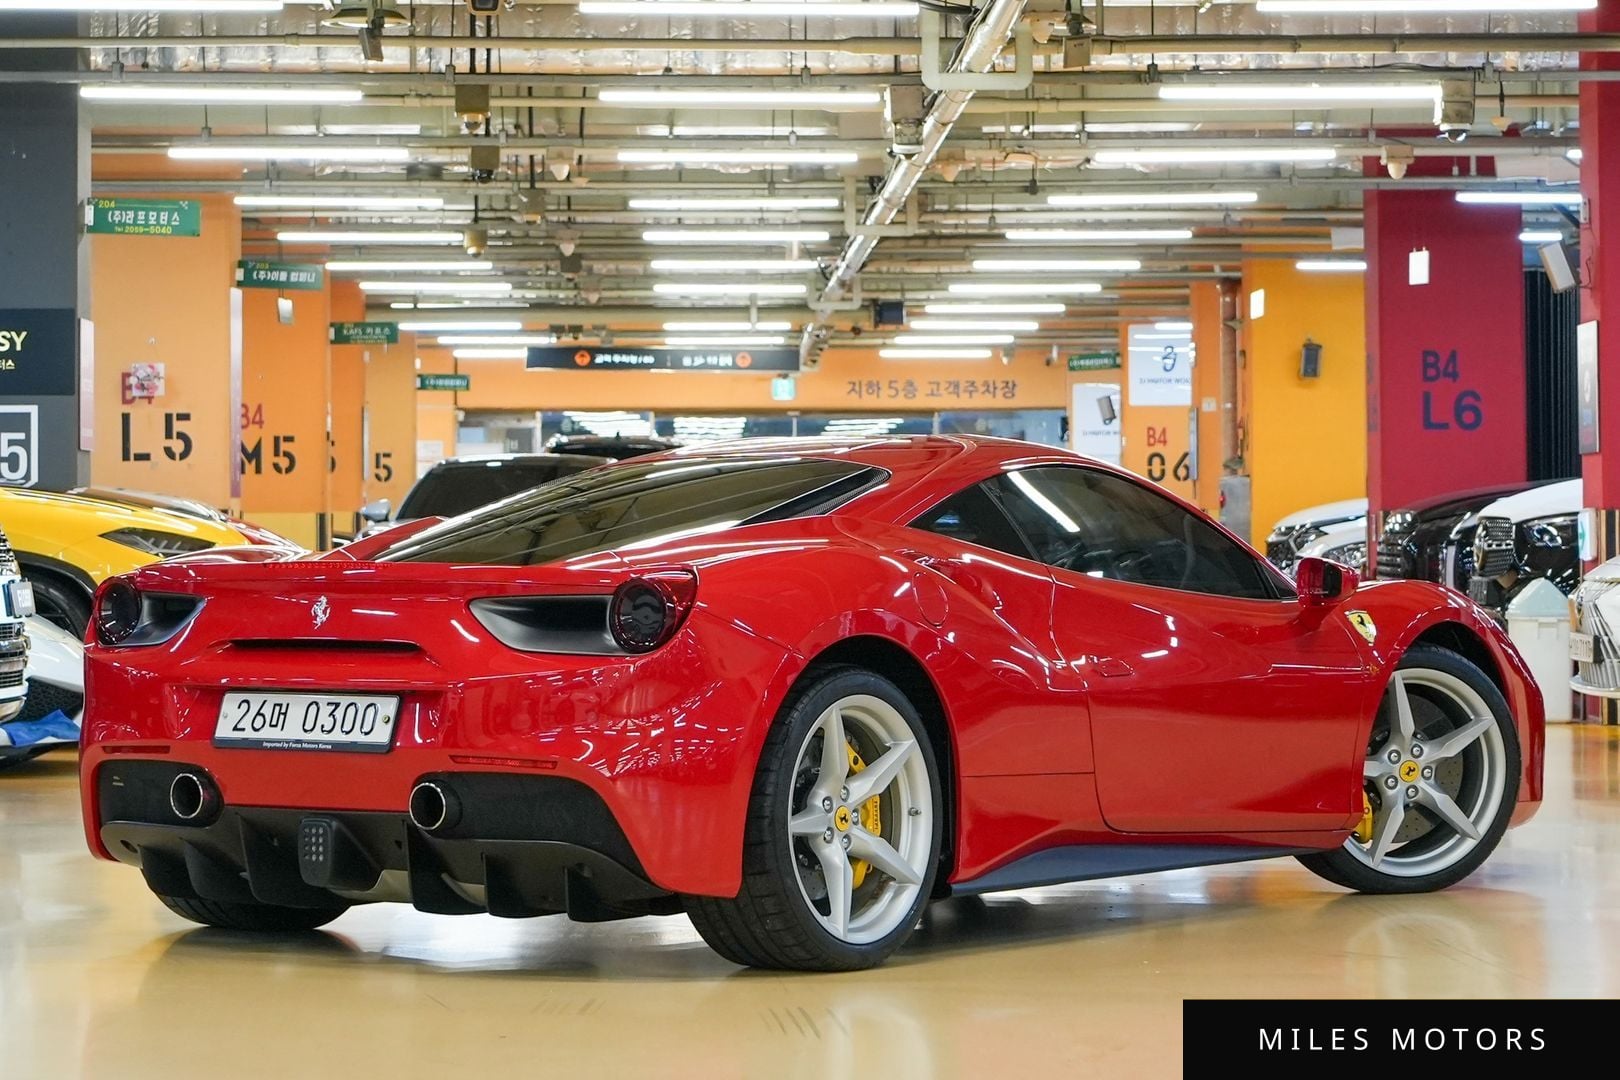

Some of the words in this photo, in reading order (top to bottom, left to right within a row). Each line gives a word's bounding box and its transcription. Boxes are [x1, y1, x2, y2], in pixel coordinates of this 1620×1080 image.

[98, 199, 116, 209] 204
[1421, 350, 1459, 383] B4
[846, 379, 882, 400] 지하
[925, 379, 1018, 400] 고객주차장
[1422, 390, 1483, 430] L6
[121, 412, 193, 462] L5
[1146, 427, 1167, 447] B4
[240, 435, 296, 475] M5
[374, 452, 393, 482] 5
[232, 699, 290, 733] 26머
[302, 701, 379, 736] 0300
